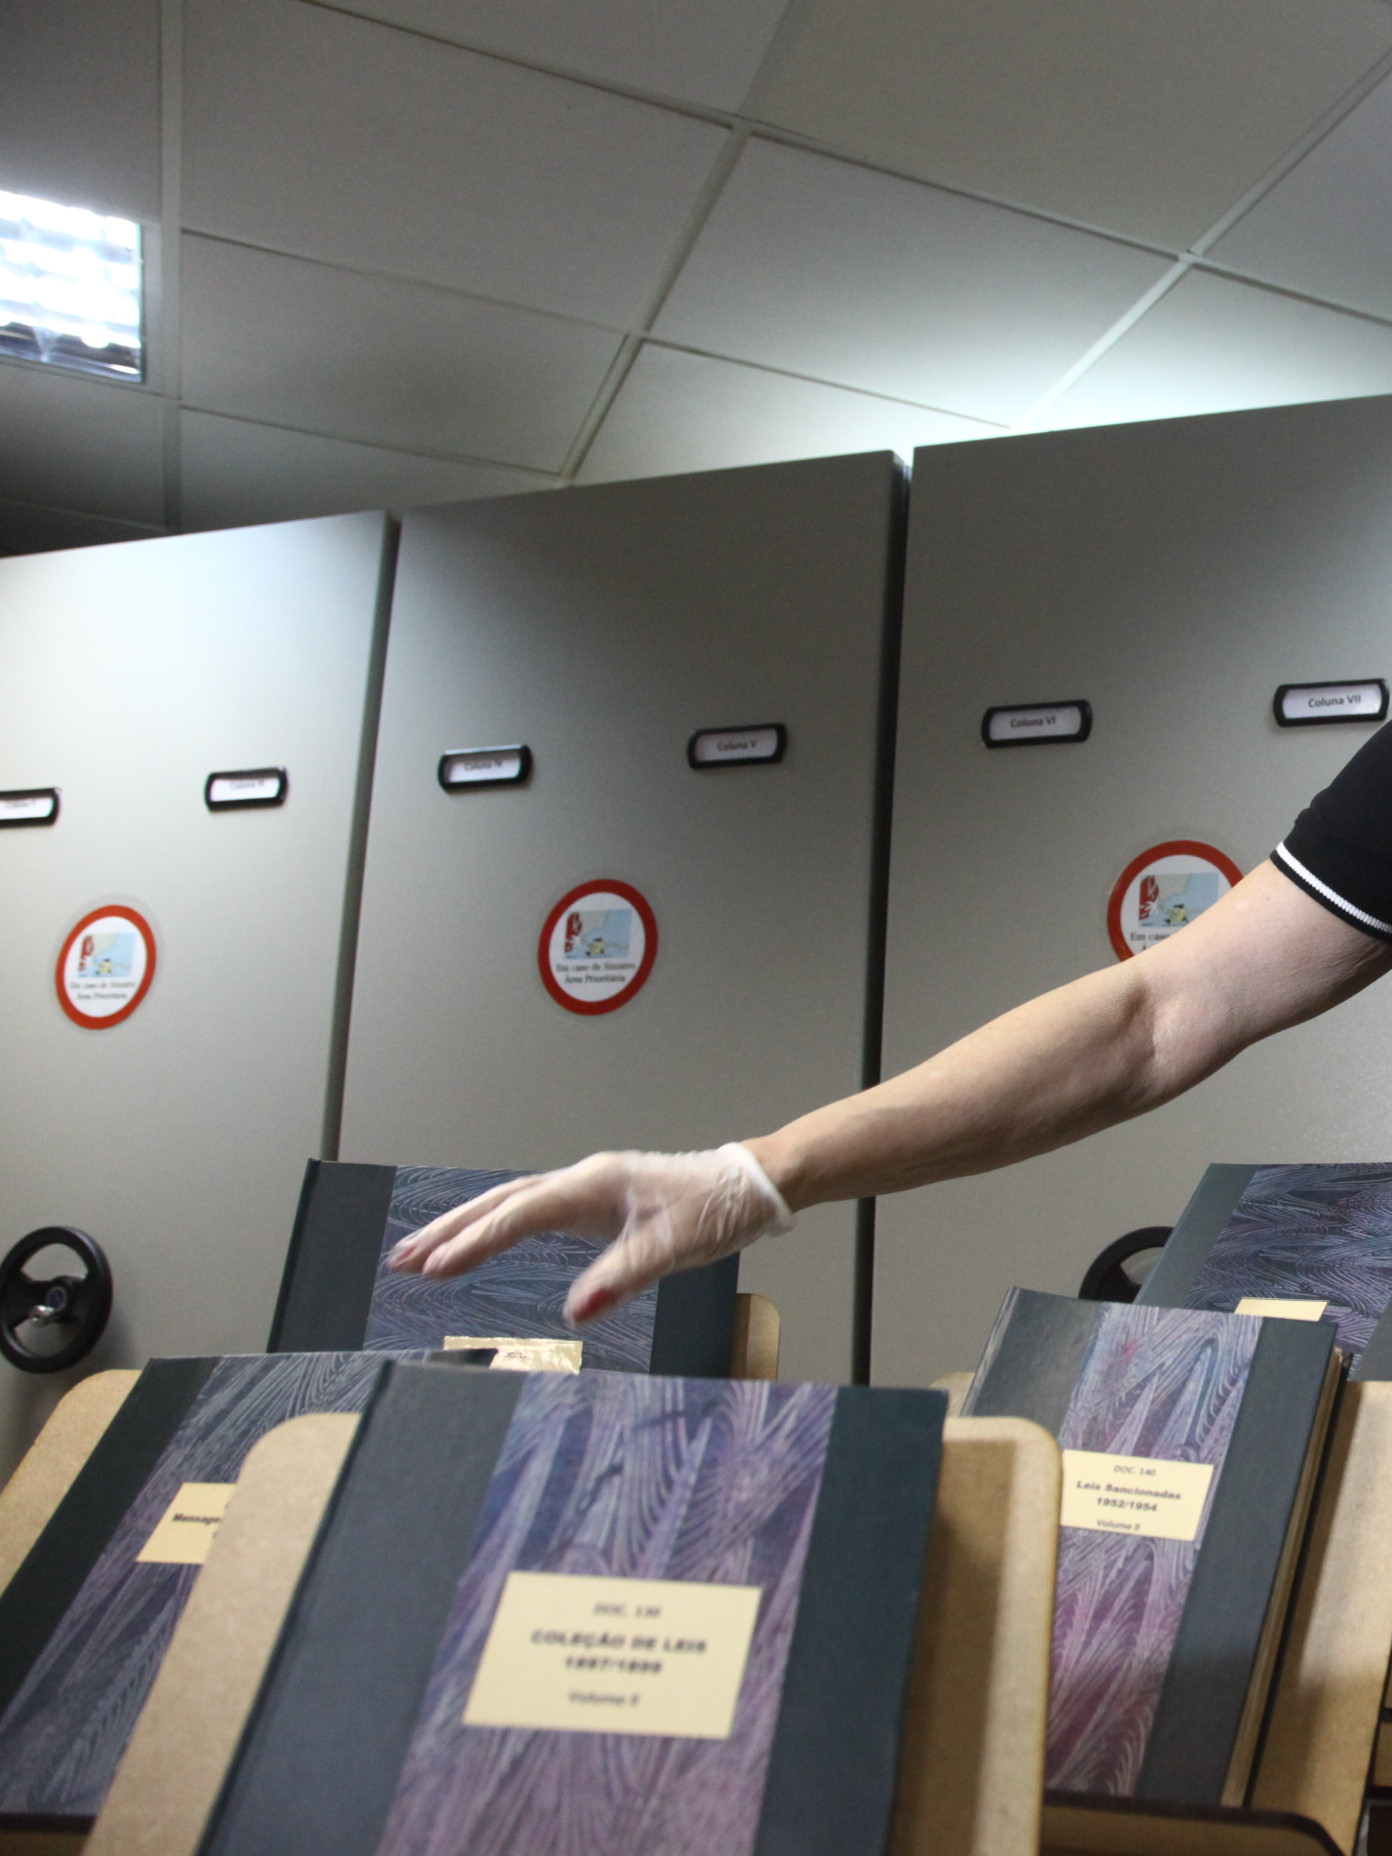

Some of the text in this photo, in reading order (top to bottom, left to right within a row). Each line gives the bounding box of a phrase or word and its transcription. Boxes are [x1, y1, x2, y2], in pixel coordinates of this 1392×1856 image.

[1308, 694, 1361, 708] Coluna VII
[1010, 715, 1056, 728] Coluna VI
[1131, 932, 1146, 941] Em
[1114, 1465, 1136, 1474] DOC.
[1077, 1480, 1181, 1500] Leis Sancionadas
[1097, 1497, 1157, 1512] 1952/1954
[1096, 1519, 1132, 1530] Volume
[531, 1627, 707, 1653] COLEÇÃO DE LEIS
